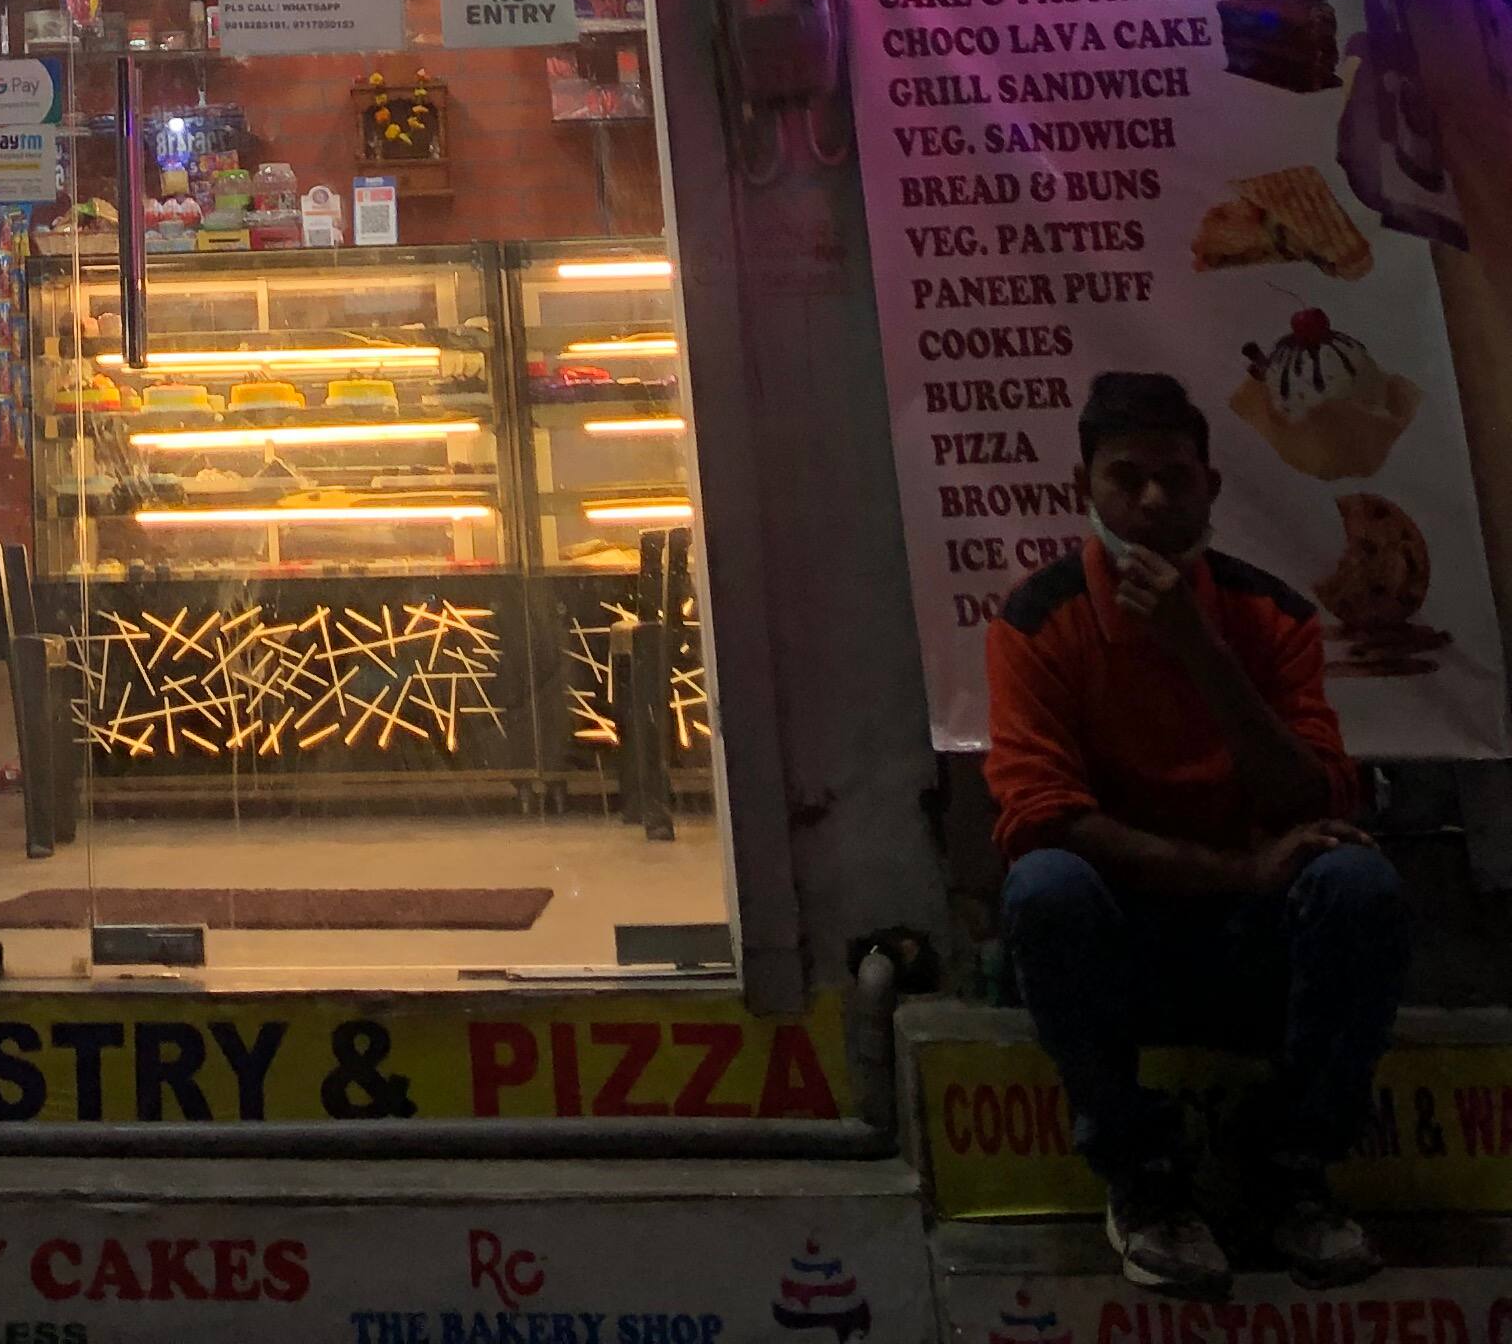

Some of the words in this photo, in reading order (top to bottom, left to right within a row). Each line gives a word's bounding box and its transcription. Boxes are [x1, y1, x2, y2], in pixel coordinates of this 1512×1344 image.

[224, 3, 244, 12] PLS
[248, 3, 274, 12] CALL
[282, 3, 341, 12] WHATSAPP
[466, 2, 557, 25] ENTRY
[882, 23, 1000, 59] CHOCO
[1010, 19, 1106, 54] LAVA
[1113, 15, 1213, 50] CAKE
[11, 76, 41, 97] Pay
[888, 73, 992, 109] GRILL
[997, 67, 1191, 106] SANDWICH
[893, 124, 976, 158] VEG.
[984, 115, 1176, 156] SANDWICH
[899, 172, 1021, 209] BREAD
[1029, 172, 1056, 203] &
[1066, 167, 1162, 201] BUNS
[905, 225, 989, 260] VEG.
[997, 219, 1146, 256] PATTIES
[912, 273, 1057, 310] PANEER
[1065, 270, 1155, 306] PUFF
[918, 324, 1074, 361] COOKIES
[923, 377, 1073, 414] BURGER
[931, 431, 1040, 466] PIZZA
[945, 537, 1008, 574] ICE
[321, 1019, 417, 1121] &
[467, 1021, 843, 1121] PIZZA
[29, 1238, 312, 1302] CAKES
[350, 1311, 429, 1344] THE
[441, 1311, 606, 1344] BAKERY
[618, 1312, 724, 1344] SHOP
